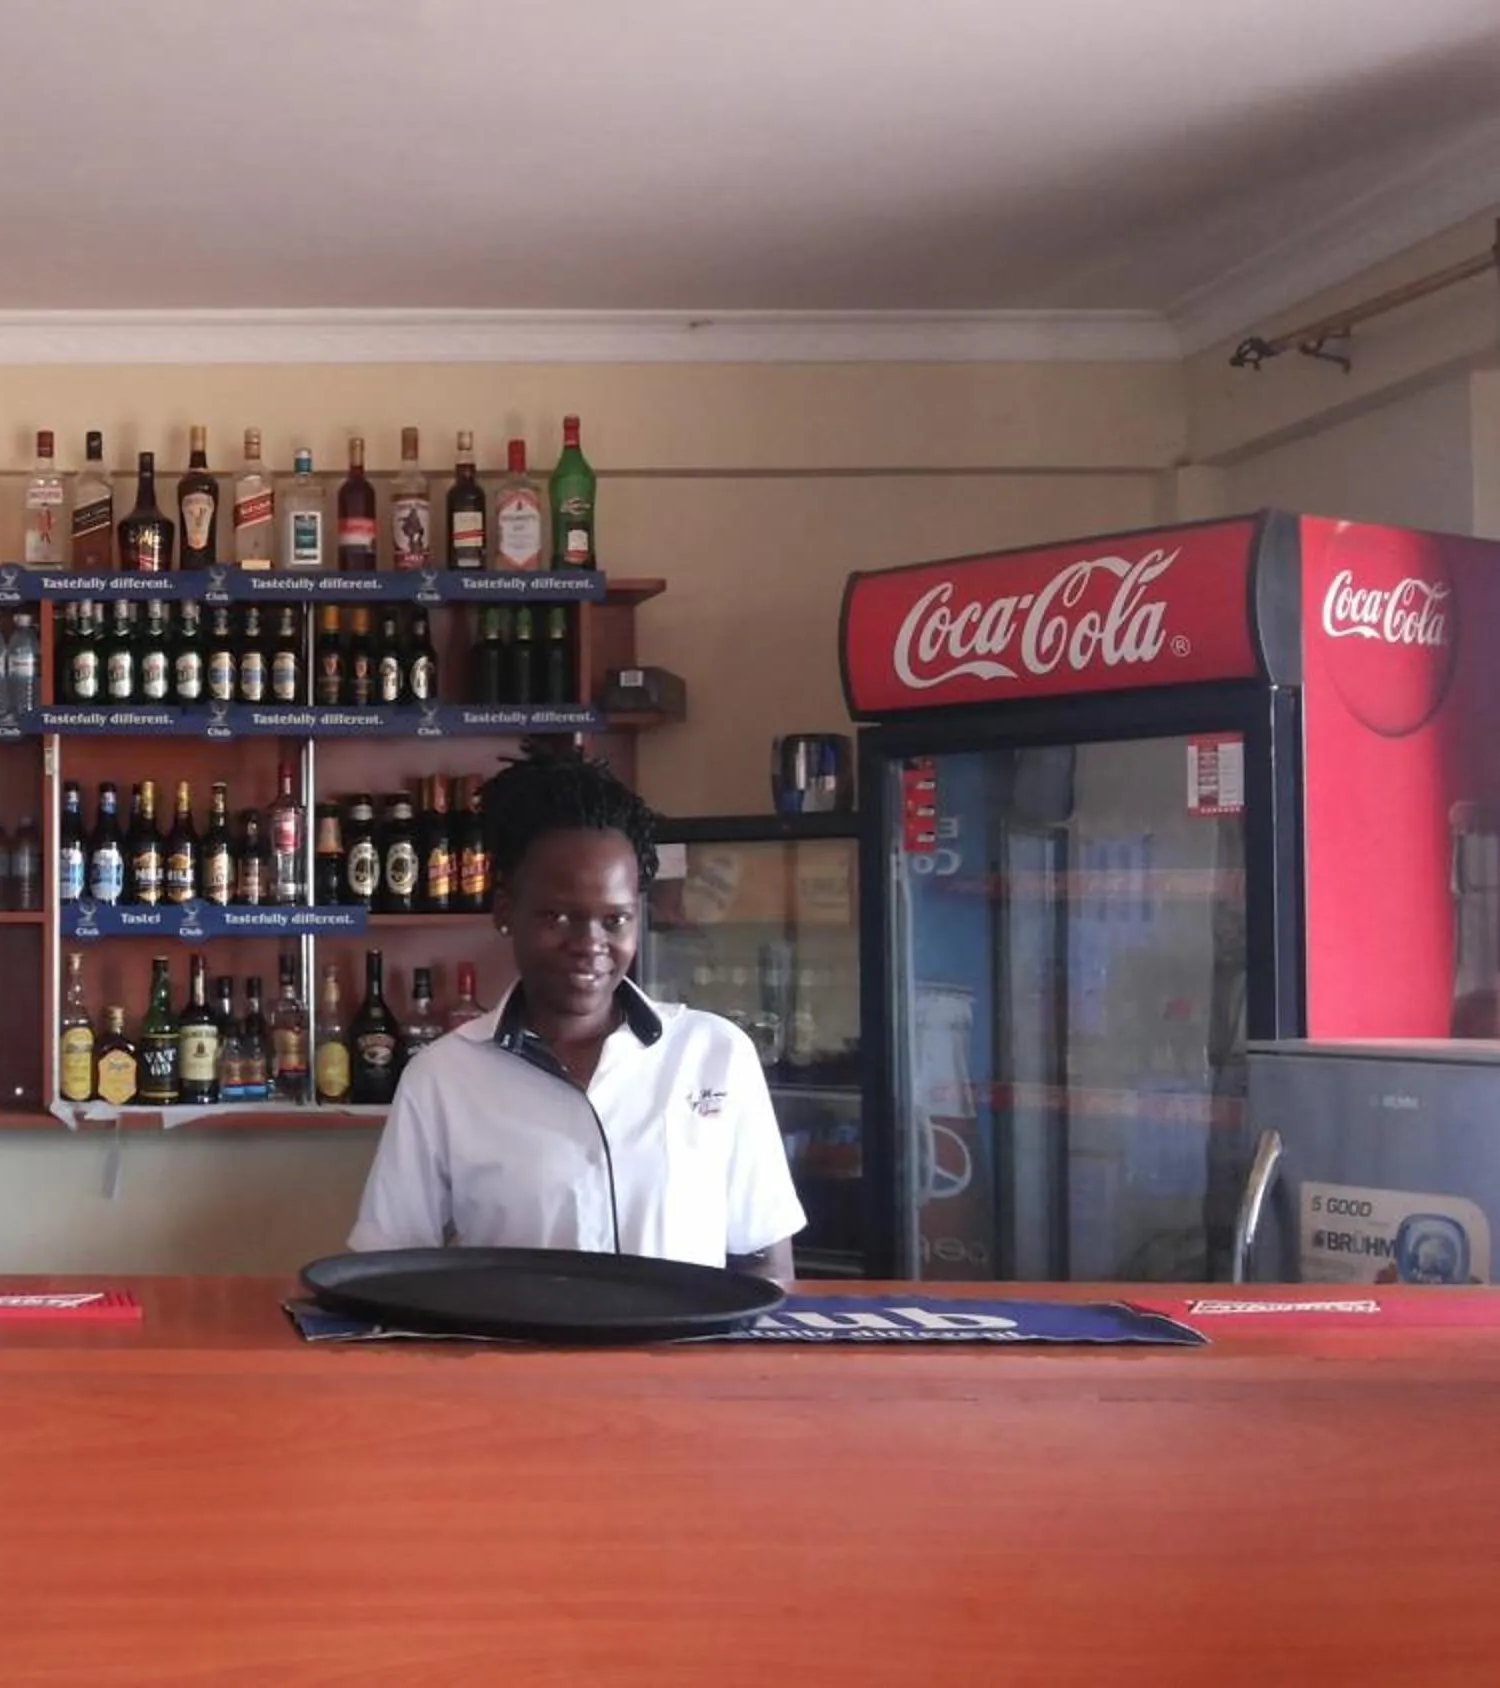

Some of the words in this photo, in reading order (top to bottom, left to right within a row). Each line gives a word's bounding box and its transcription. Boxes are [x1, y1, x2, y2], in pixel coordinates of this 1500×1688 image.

[41, 576, 105, 591] Tastefully
[251, 577, 315, 592] Tastefully
[462, 577, 526, 592] Tastefully
[1322, 569, 1451, 646] Coca-Cola
[893, 546, 1182, 689] Coca-Cola
[42, 712, 106, 728] Tastefully
[252, 712, 318, 728] Tastefully
[224, 913, 288, 928] Tastefully
[1326, 1197, 1373, 1218] GOOD
